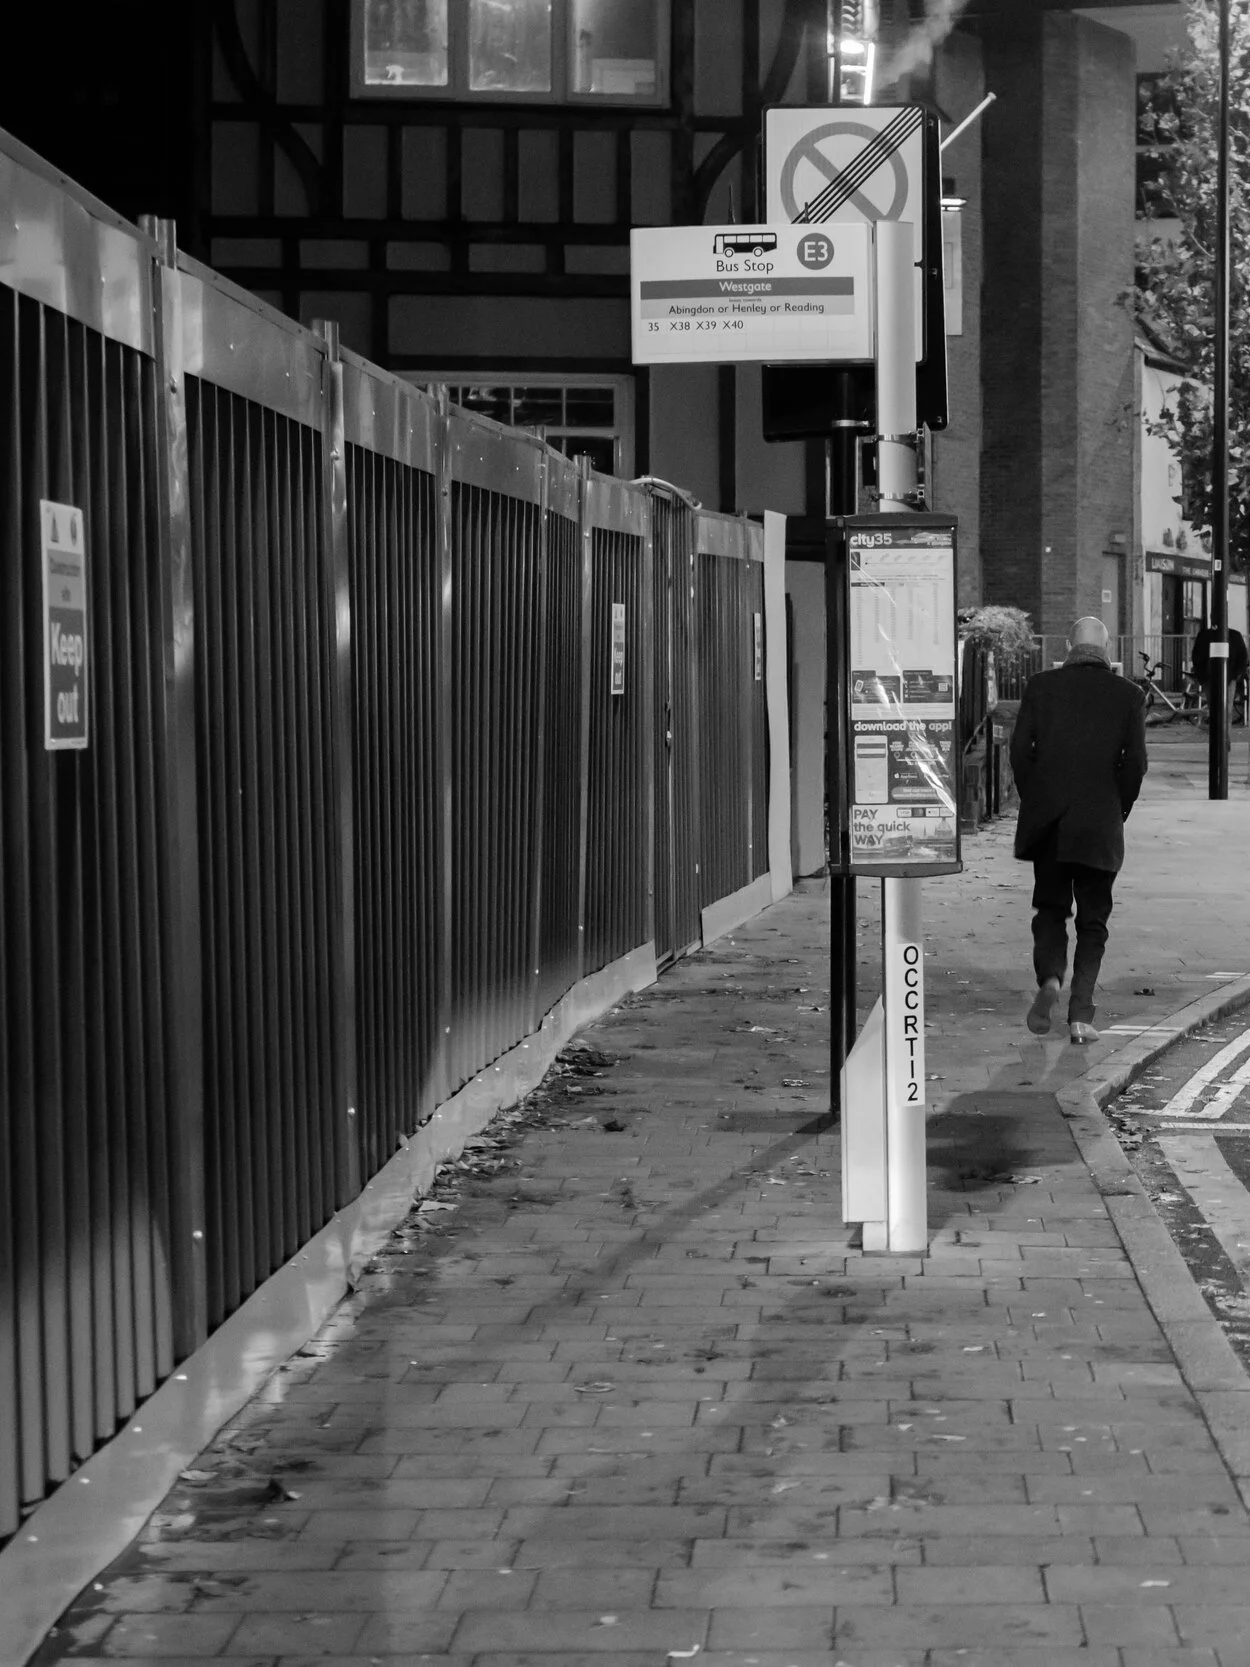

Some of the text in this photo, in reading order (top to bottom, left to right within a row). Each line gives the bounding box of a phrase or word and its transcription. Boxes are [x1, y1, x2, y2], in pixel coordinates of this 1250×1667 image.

[803, 241, 829, 262] E3
[716, 259, 774, 274] Bus Stop
[718, 281, 772, 294] Westgate
[668, 305, 715, 316] Abingdon
[732, 304, 767, 315] Henley
[784, 302, 825, 314] Reading
[648, 320, 744, 332] 35 X38 X39 X40
[51, 621, 83, 677] Keep
[57, 683, 79, 724] out
[854, 721, 907, 732] download
[908, 720, 926, 731] the
[854, 809, 878, 820] PAY
[853, 820, 911, 836] the quick
[854, 834, 883, 846] WAY
